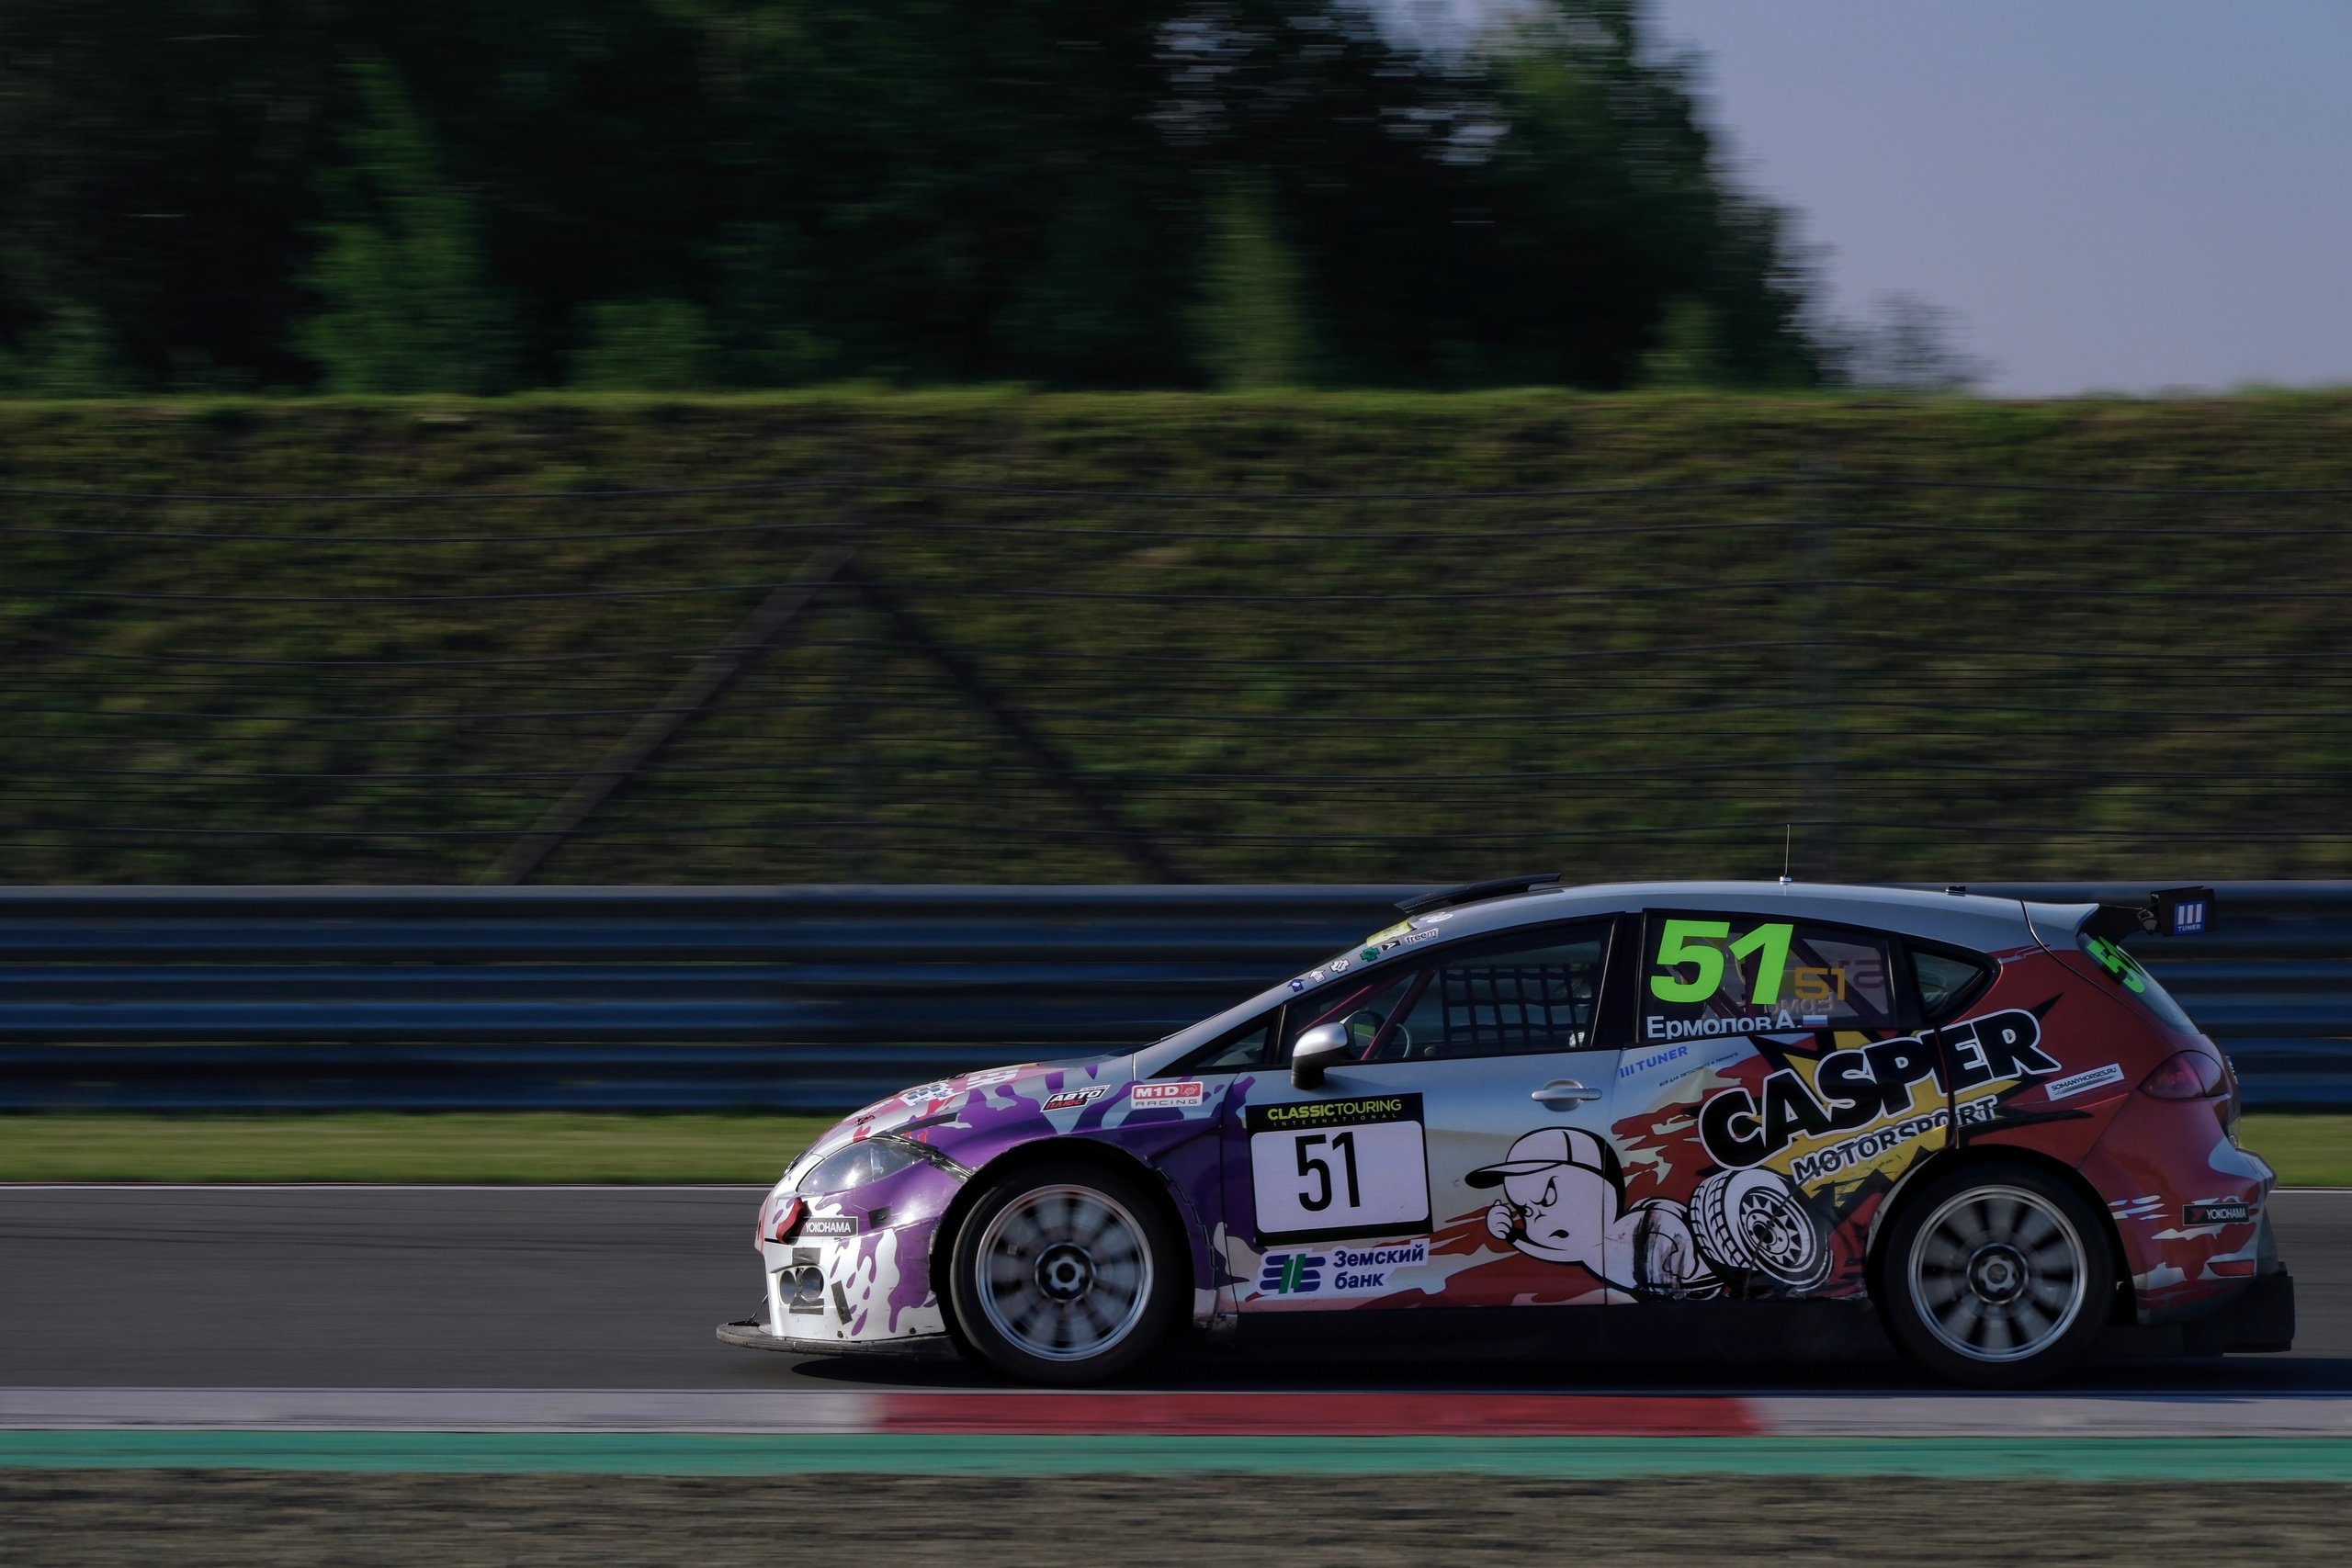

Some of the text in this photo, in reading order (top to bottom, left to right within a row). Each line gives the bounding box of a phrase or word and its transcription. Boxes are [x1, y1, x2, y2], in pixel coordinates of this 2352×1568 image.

[1406, 930, 1437, 943] freem
[1650, 919, 1793, 1005] 51
[1794, 967, 1845, 1000] 51
[1646, 1015, 1771, 1040] Ермолов
[1636, 1046, 1688, 1071] TUNER
[1699, 1010, 2061, 1169] CASPER
[2051, 1067, 2117, 1091] SOMANYHORSES.RU
[1049, 1089, 1102, 1102] АВТО
[1136, 1086, 1179, 1098] M1D
[1273, 1113, 1396, 1127] INTERNATIONAL
[1792, 1096, 1997, 1182] MOTORSPORT
[1295, 1131, 1361, 1212] 51
[2207, 1208, 2246, 1219] YOKOHAMA
[805, 1222, 851, 1233] YOKOHAMA
[1333, 1244, 1424, 1268] Земский
[1334, 1271, 1385, 1290] банк
